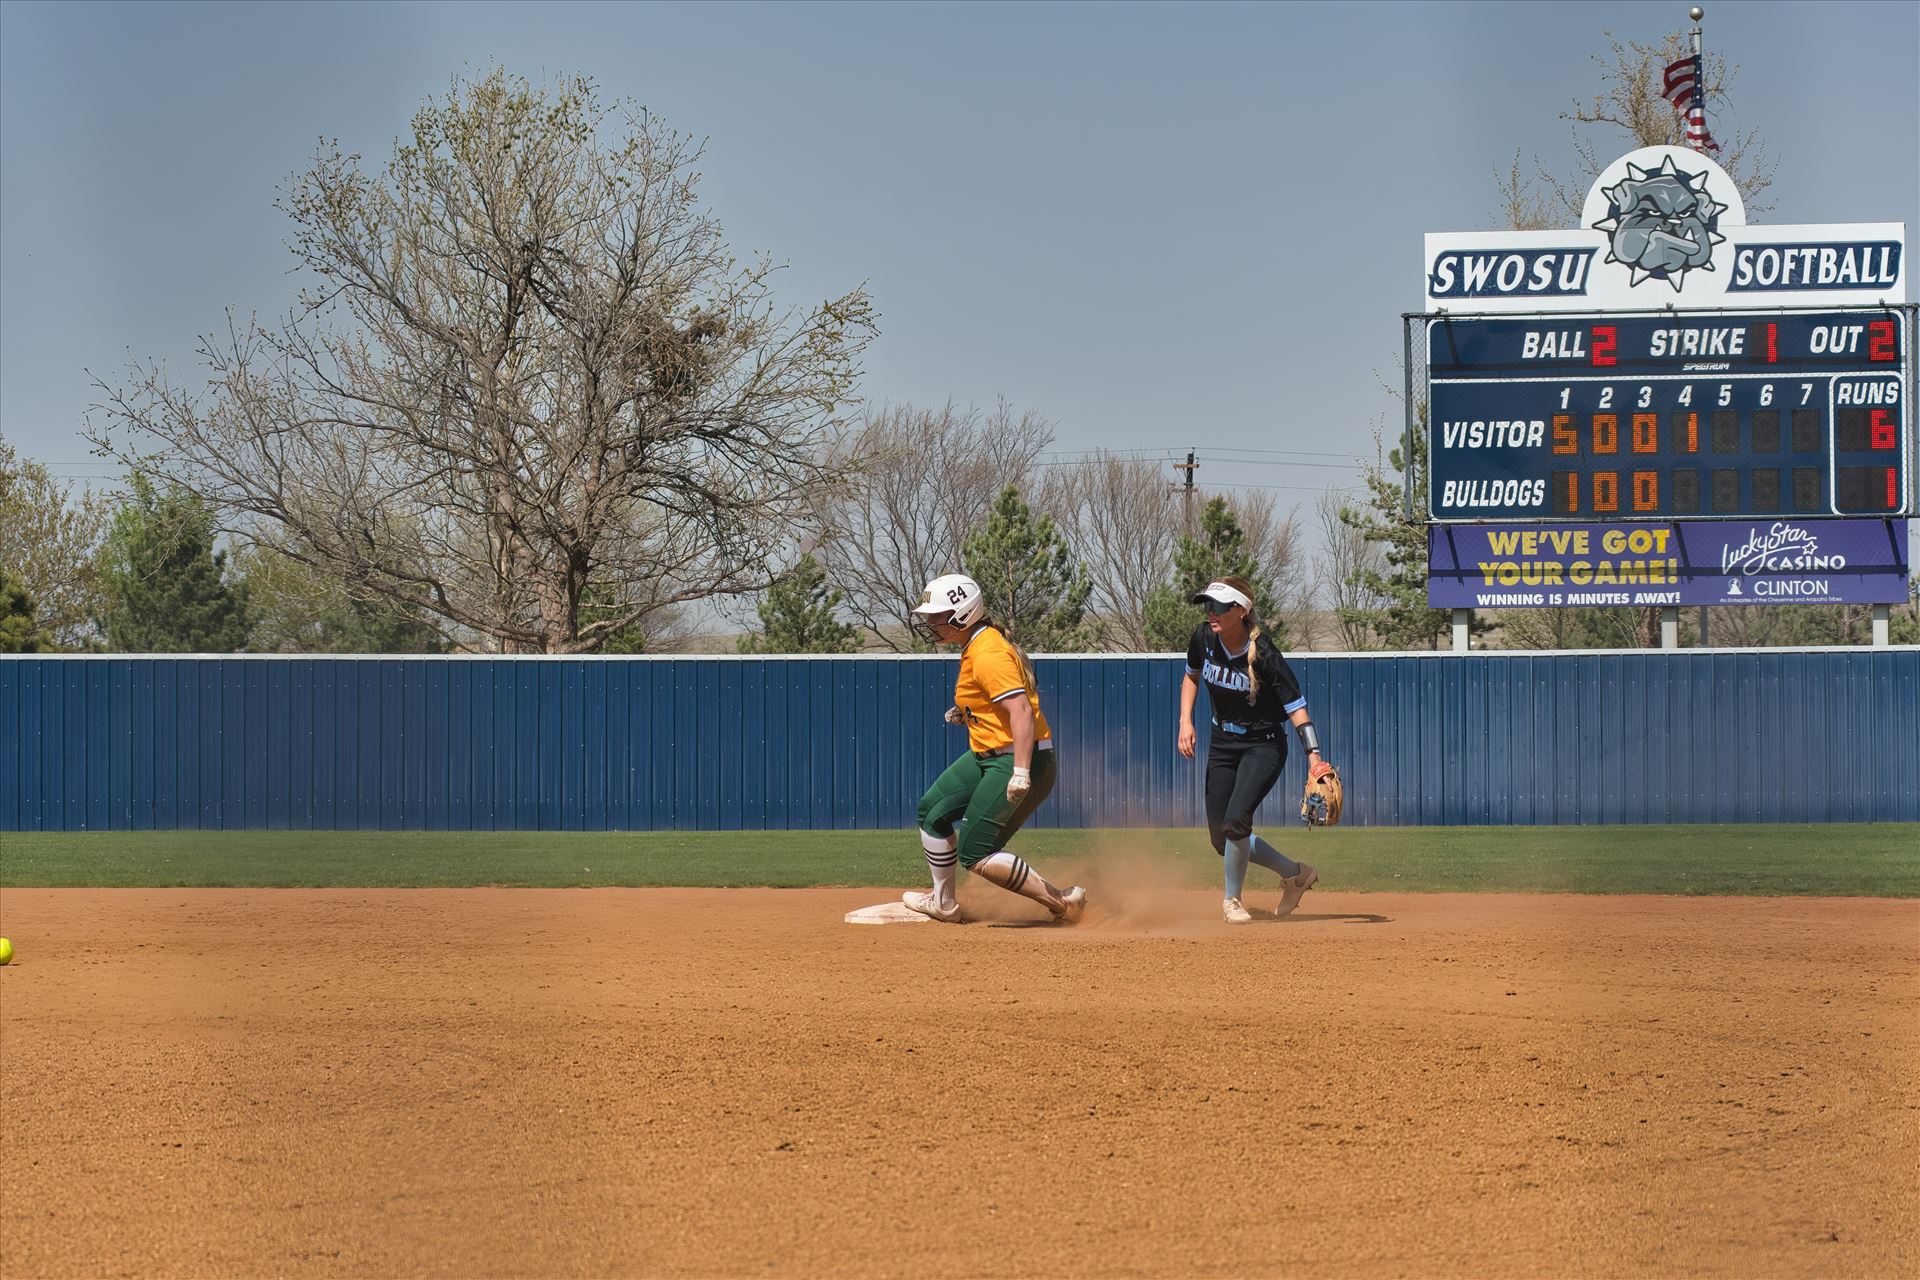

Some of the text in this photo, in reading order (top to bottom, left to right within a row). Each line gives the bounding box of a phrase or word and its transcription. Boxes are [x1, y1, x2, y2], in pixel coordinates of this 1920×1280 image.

[1433, 254, 1590, 293] SWOSU
[1736, 246, 1896, 286] SOFTBALL
[1521, 326, 1617, 366] BALL 2
[1650, 323, 1777, 363] STRIKE 1
[1809, 321, 1895, 361] OUT 2
[1682, 362, 1730, 371] SPECTRUM
[1560, 383, 1813, 409] 1 2 3 4 5 6 7
[1837, 382, 1899, 405] RUNS
[1443, 412, 1698, 454] VISITOR 5 0 0 1
[1871, 409, 1896, 449] 6
[1442, 471, 1658, 512] BULLDOGS 1 0 0
[1887, 467, 1896, 508] 1
[1487, 529, 1670, 556] WE'VE GOT
[1478, 558, 1678, 587] YOUR GAME!
[1766, 555, 1846, 571] CASINO
[946, 585, 968, 605] 24
[1477, 592, 1680, 606] WINNING IS MINUTES AWAY!
[1754, 580, 1828, 595] CLINTON
